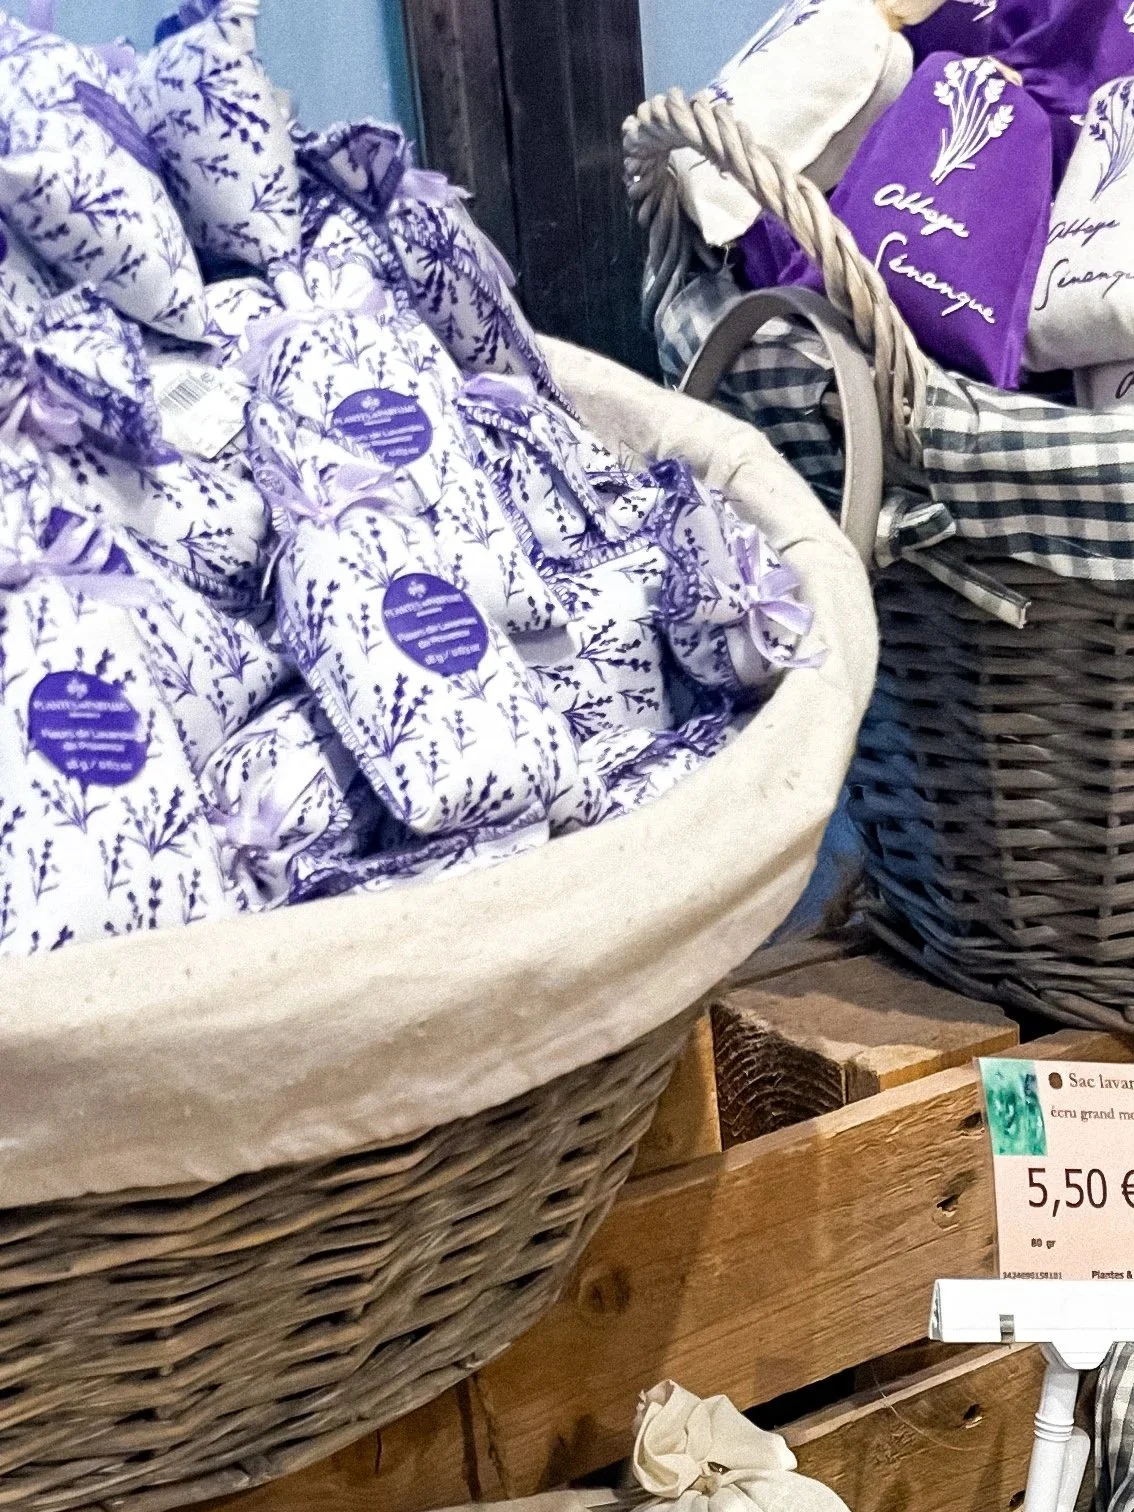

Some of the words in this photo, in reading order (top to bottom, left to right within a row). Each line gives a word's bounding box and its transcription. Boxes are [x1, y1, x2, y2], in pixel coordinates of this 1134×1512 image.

[1068, 1072, 1096, 1088] Sac
[1050, 1105, 1077, 1119] écru
[1080, 1107, 1116, 1123] grand
[1027, 1167, 1108, 1218] 5,50
[1091, 1270, 1125, 1280] Plantes
[1126, 1270, 1133, 1280] &
